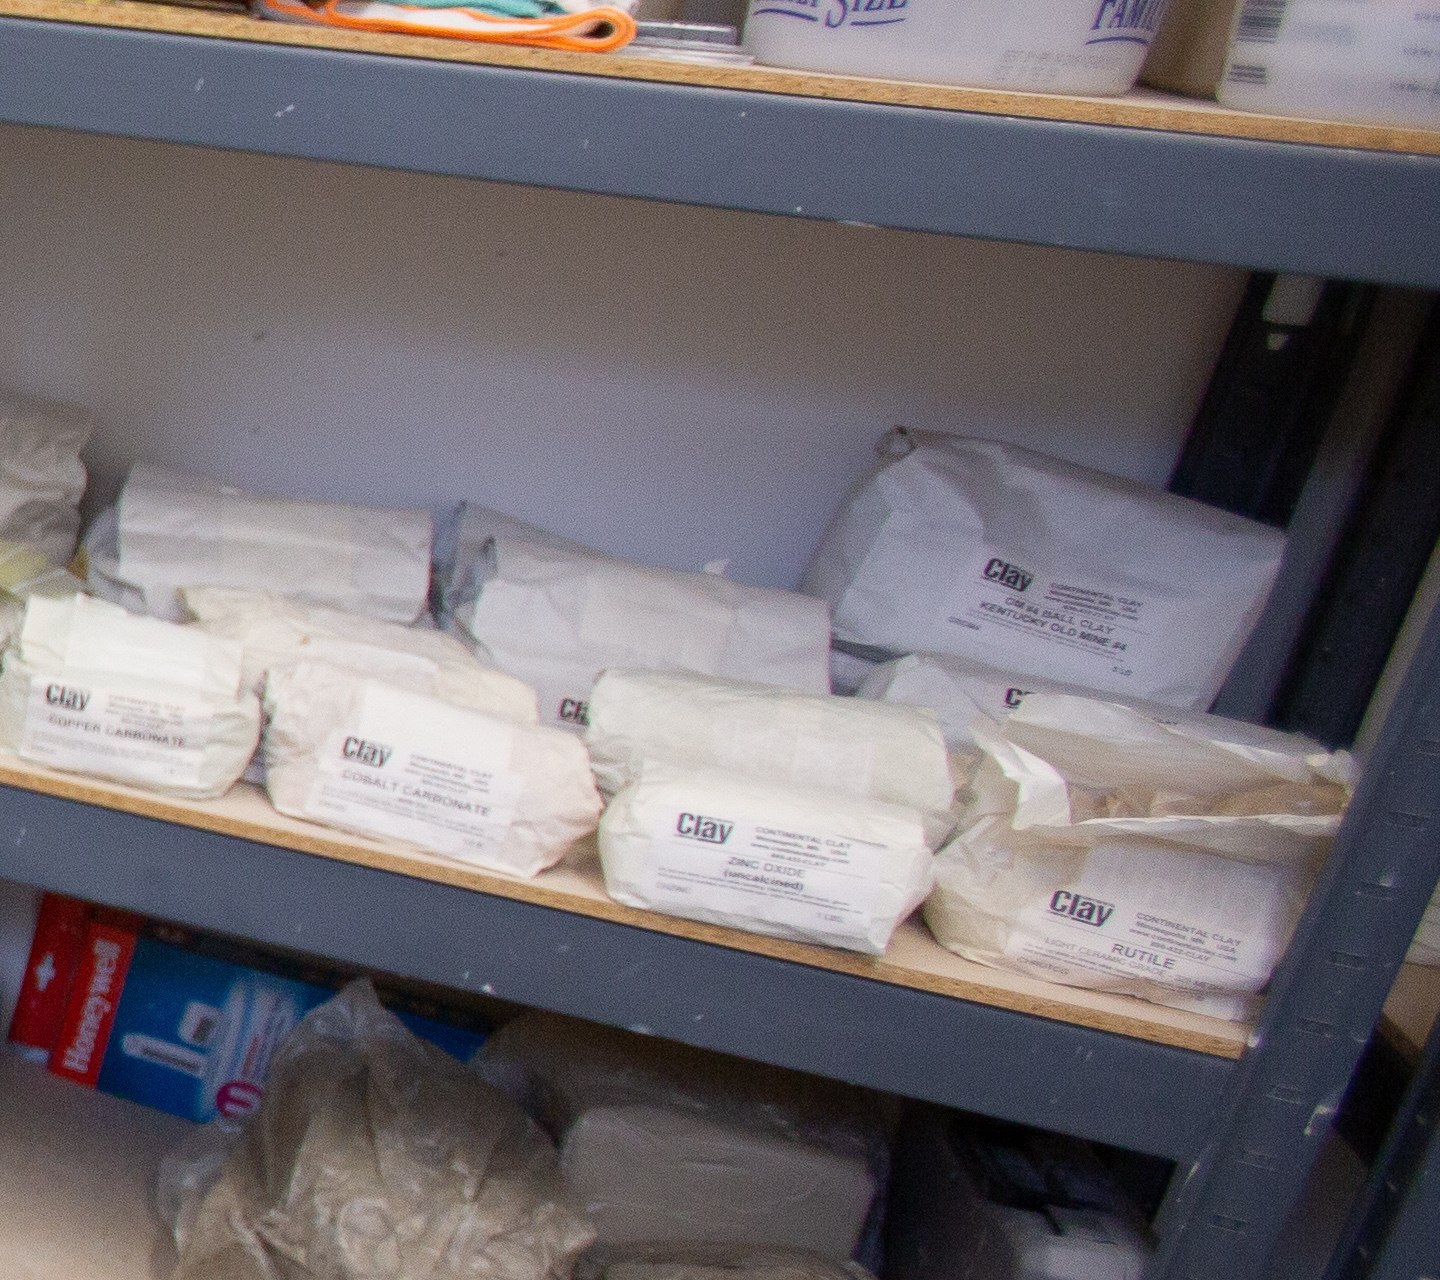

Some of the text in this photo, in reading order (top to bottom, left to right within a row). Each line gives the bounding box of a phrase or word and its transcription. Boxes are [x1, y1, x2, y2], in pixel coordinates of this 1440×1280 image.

[983, 558, 1032, 592] Clay
[979, 600, 1048, 628] KENTUCKY
[1050, 622, 1078, 637] OLD
[1078, 631, 1110, 647] MINE
[1042, 609, 1076, 625] BALL
[1080, 619, 1116, 635] CLAY
[45, 682, 91, 712] Clay
[341, 735, 393, 768] Clay
[676, 812, 733, 844] Clay
[724, 869, 804, 892] (uncalcined)
[728, 856, 806, 879] ZINC OXIDE
[1049, 890, 1114, 928] Clay
[1136, 912, 1242, 947] CONTINENTAL CLAY
[1111, 943, 1176, 970] RUTILE
